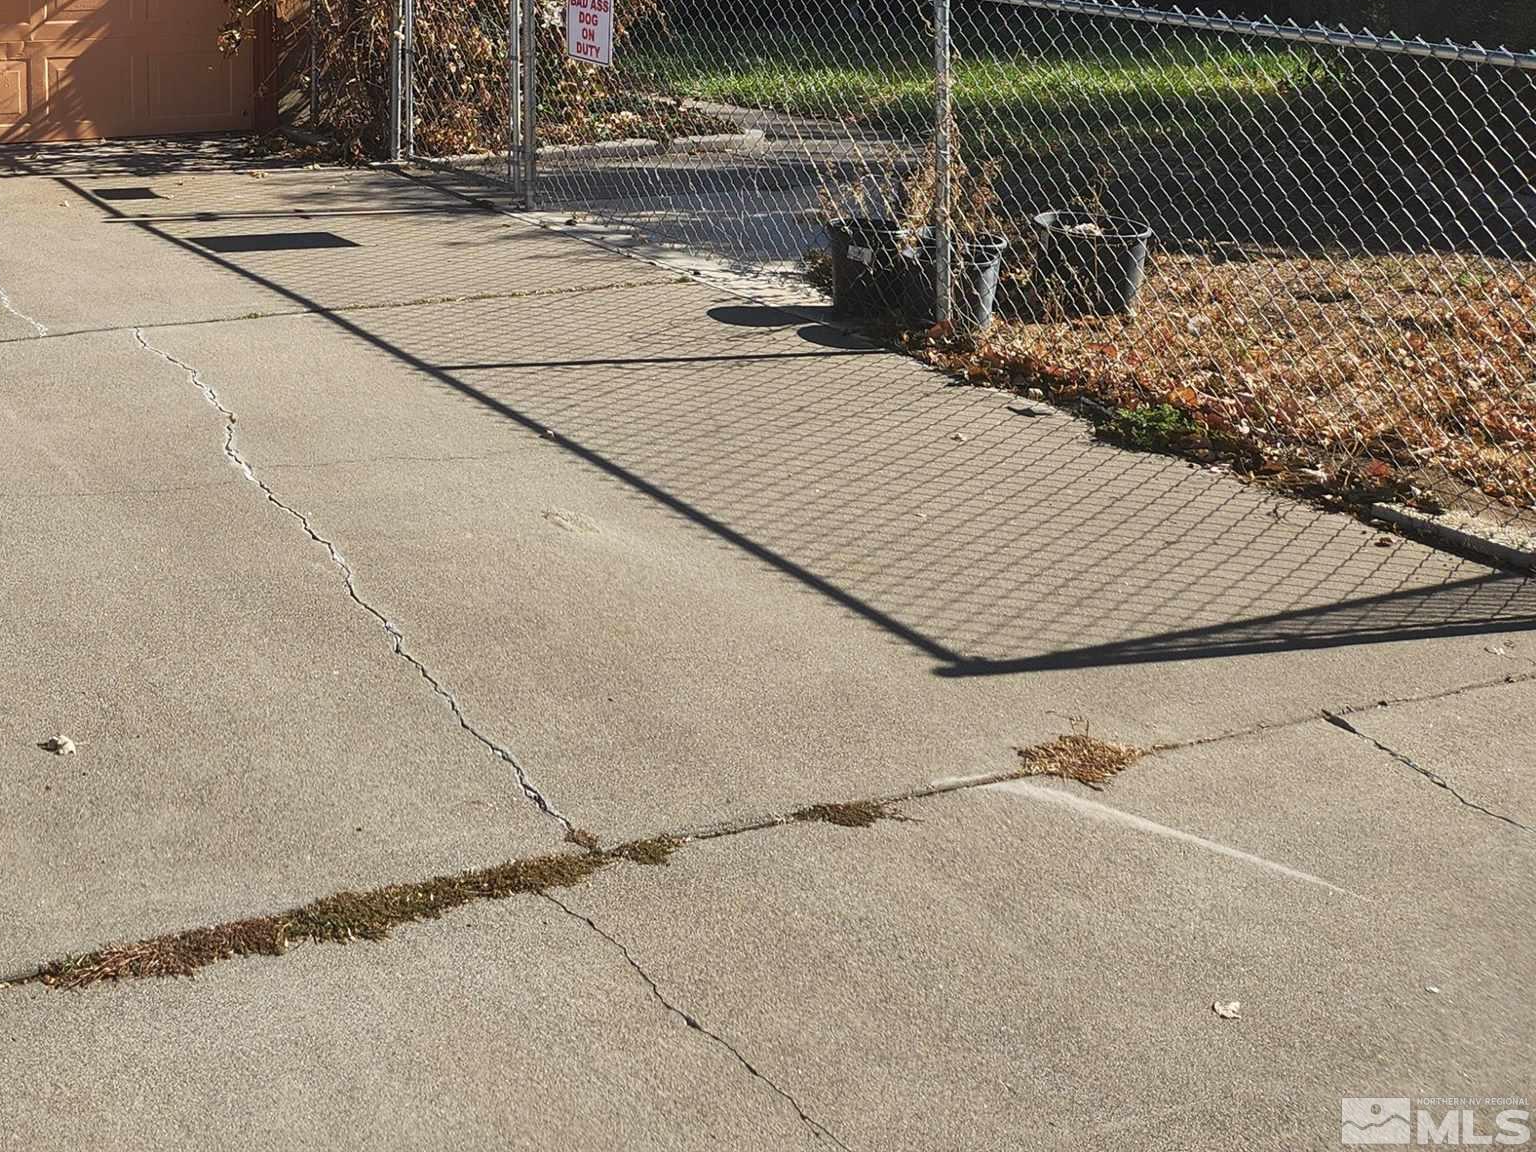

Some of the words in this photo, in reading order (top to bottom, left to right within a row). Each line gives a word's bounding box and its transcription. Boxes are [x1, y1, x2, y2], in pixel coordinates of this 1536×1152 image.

[579, 11, 598, 25] DOG
[582, 28, 595, 41] ON
[576, 41, 600, 58] DUTY
